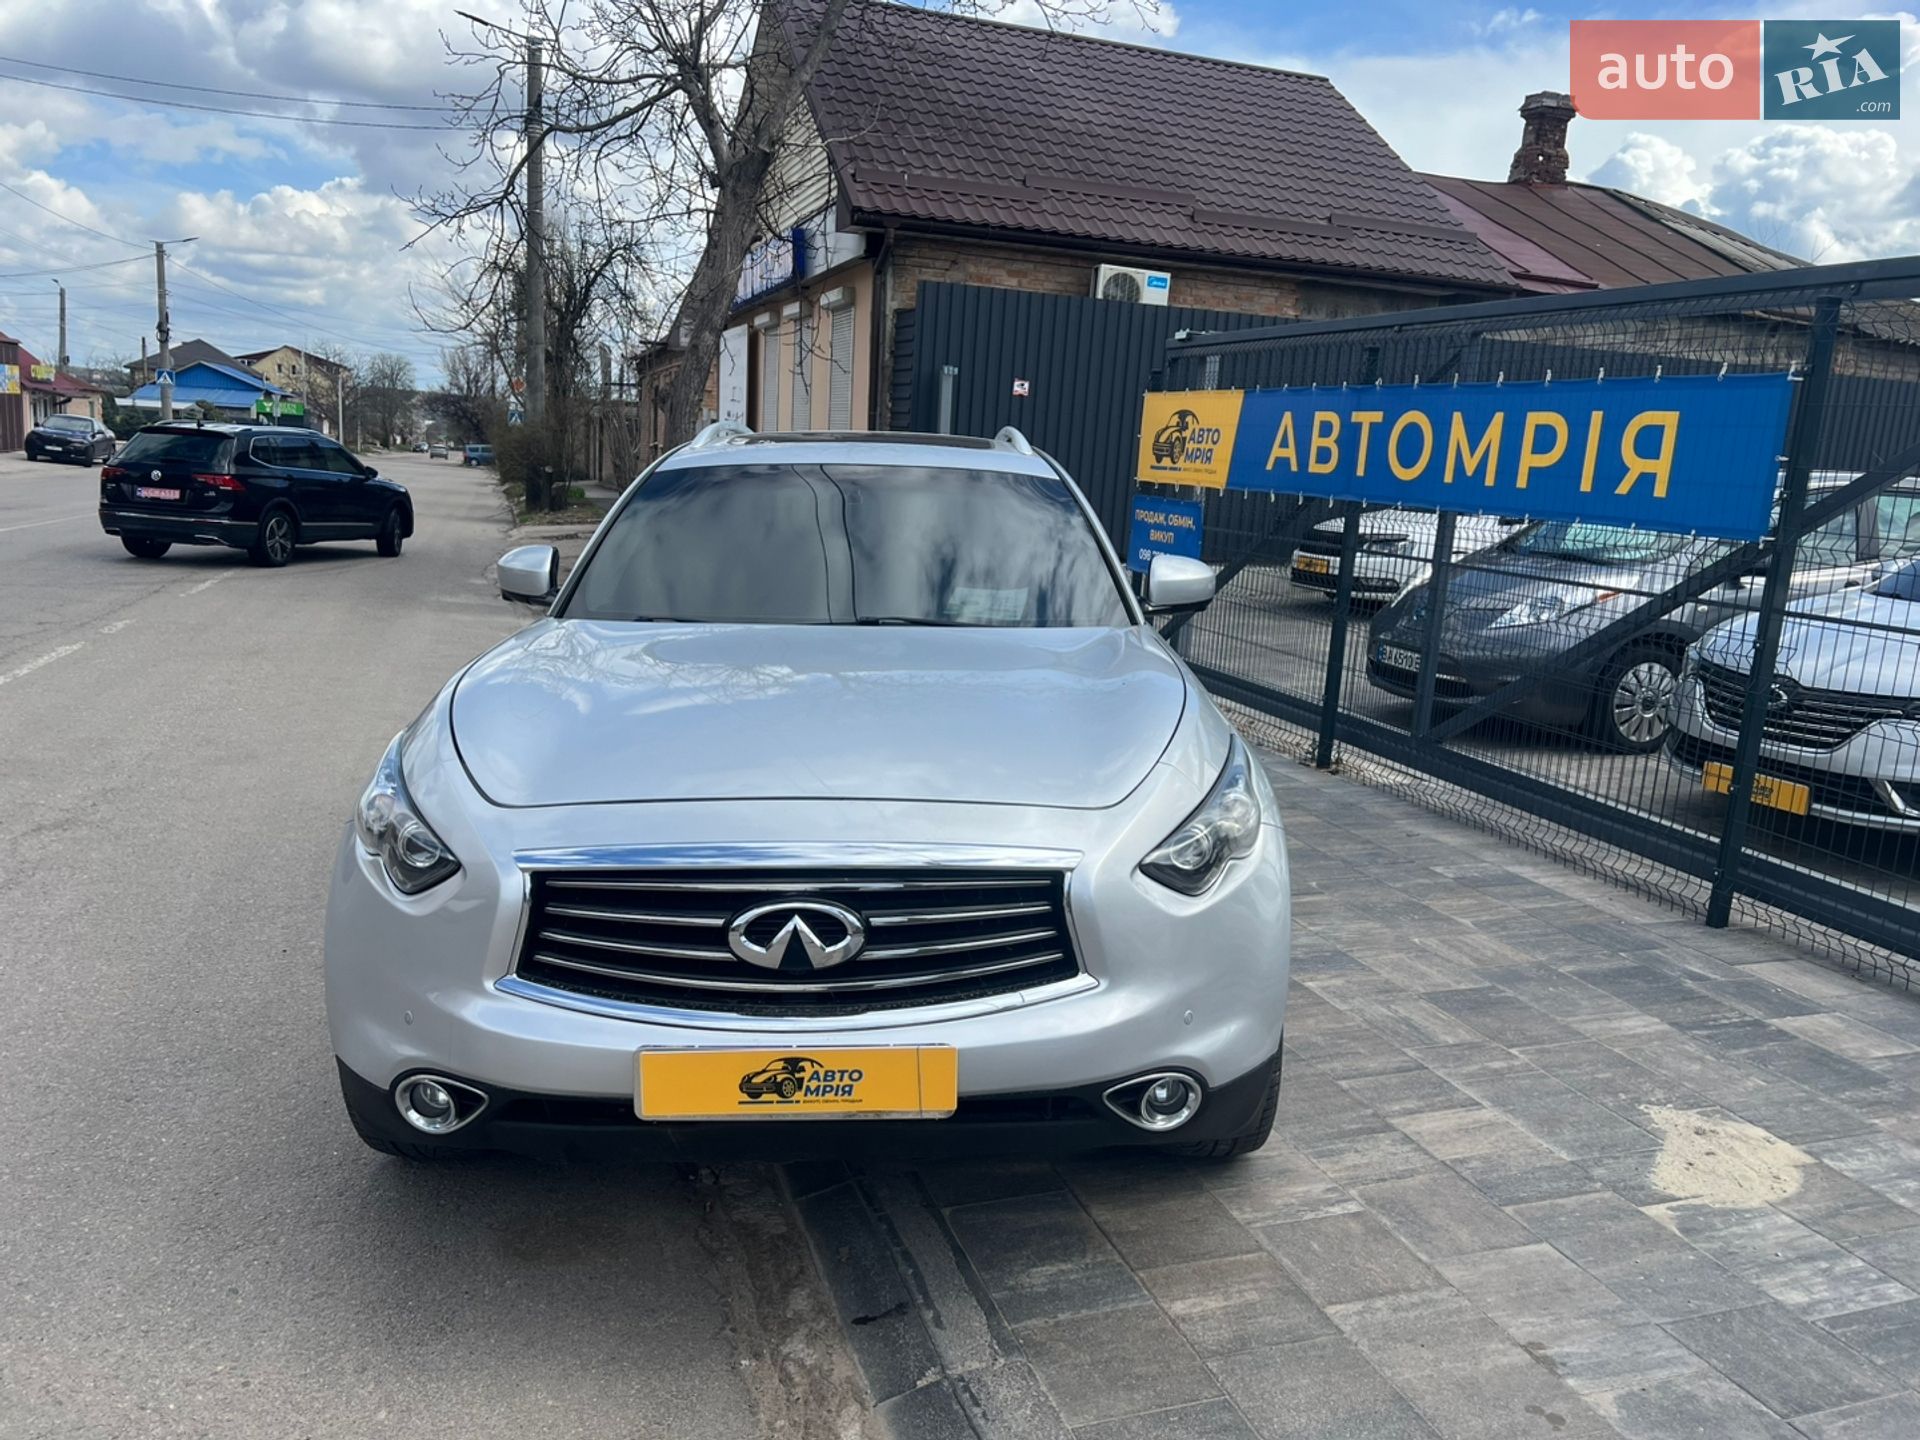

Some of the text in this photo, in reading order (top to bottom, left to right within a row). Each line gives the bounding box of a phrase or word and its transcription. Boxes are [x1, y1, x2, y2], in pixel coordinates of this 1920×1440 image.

[1187, 427, 1221, 445] АВТО
[1184, 446, 1214, 464] МРІЯ
[1265, 410, 1680, 498] АВТОМРІЯ
[1135, 509, 1196, 531] ПРОДАЖ, ОБМІН,
[1149, 529, 1174, 544] ВИКУП
[807, 1069, 863, 1082] АВТО
[804, 1084, 854, 1097] МРІЯ
